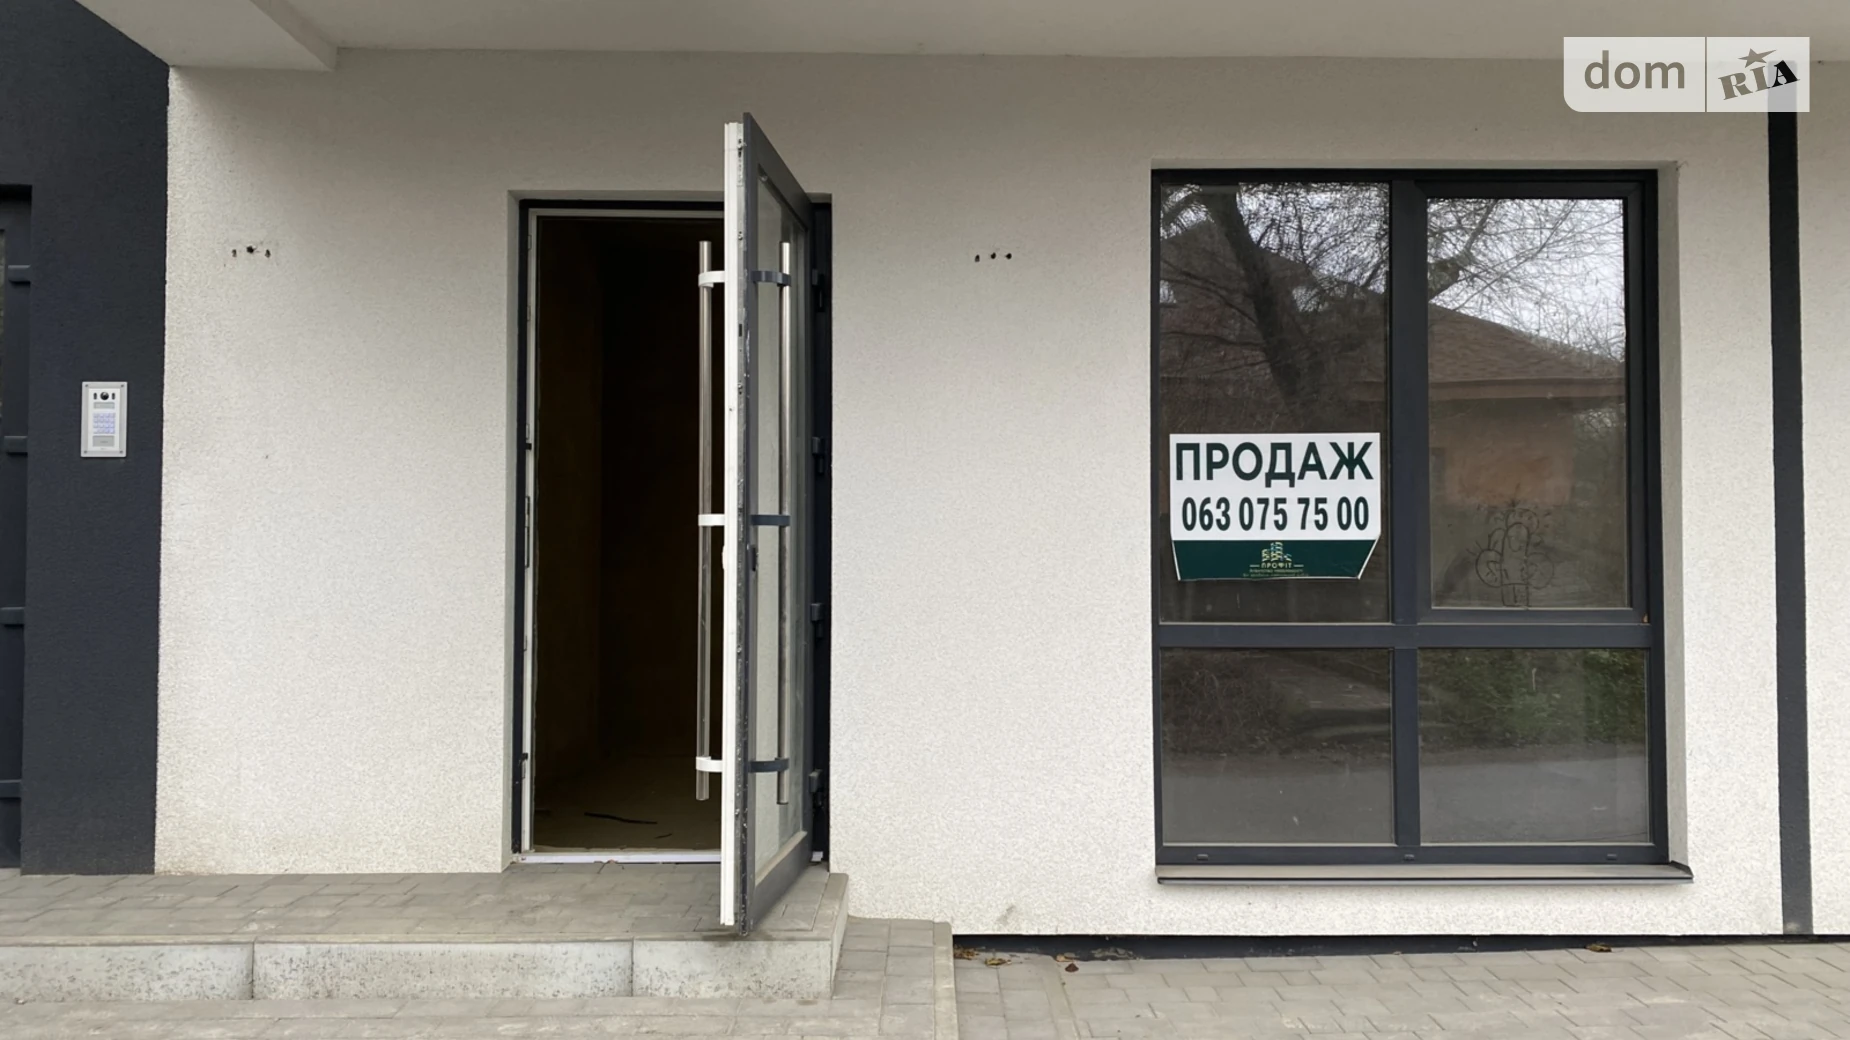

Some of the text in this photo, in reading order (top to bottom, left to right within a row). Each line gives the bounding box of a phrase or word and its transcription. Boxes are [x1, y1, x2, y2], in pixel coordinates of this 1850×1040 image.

[1176, 441, 1374, 488] ПРОДАЖ
[1182, 496, 1369, 531] 063 075 75 00
